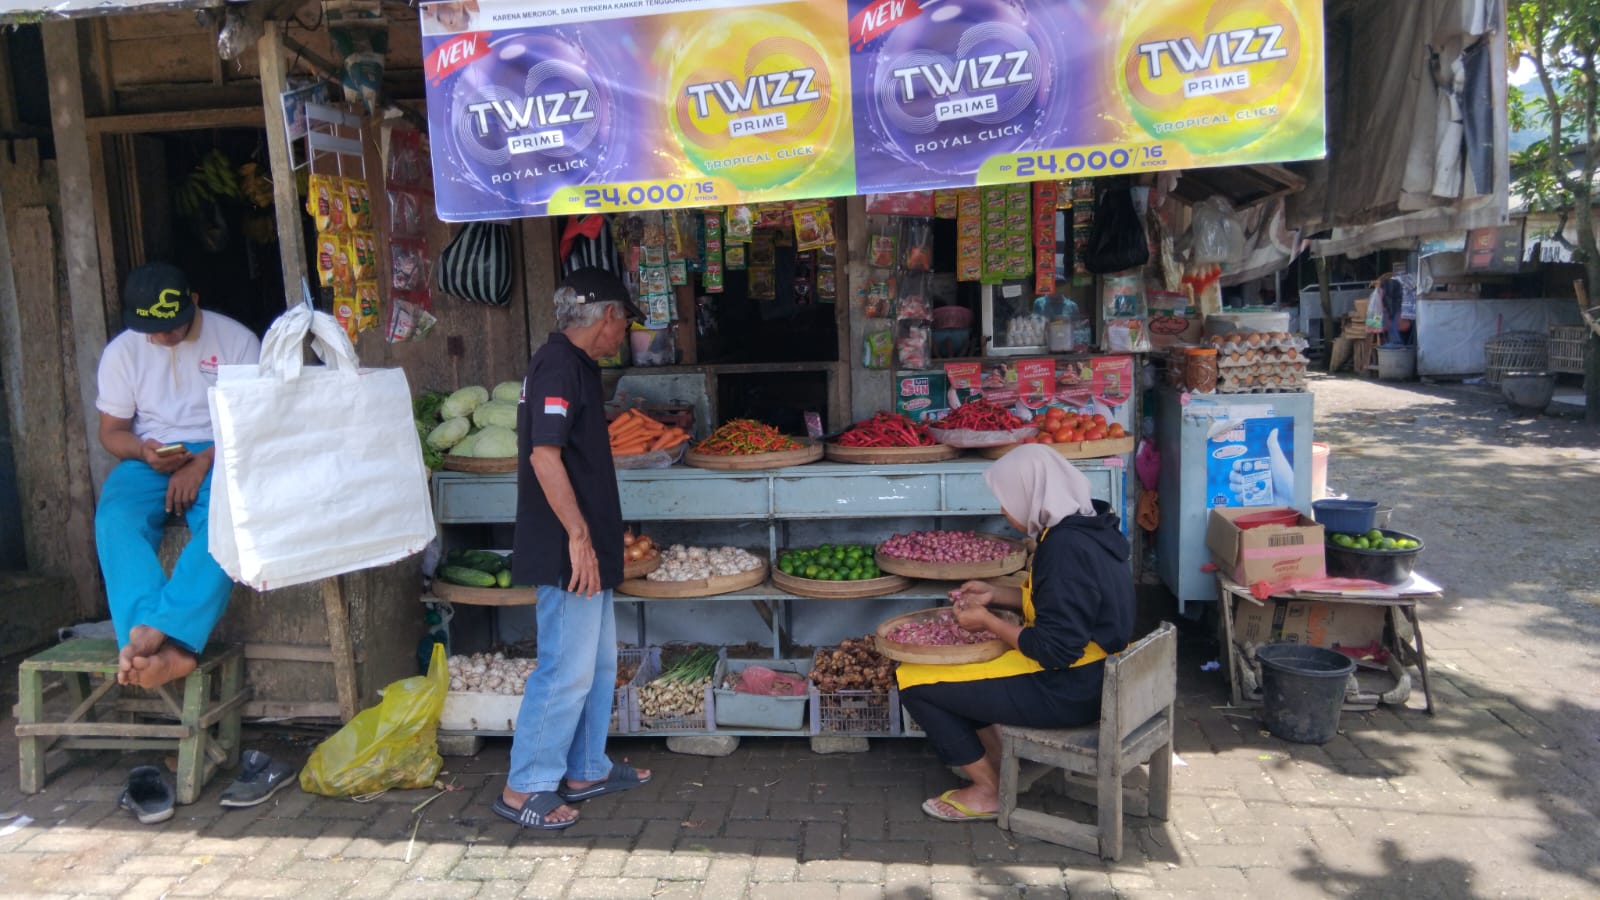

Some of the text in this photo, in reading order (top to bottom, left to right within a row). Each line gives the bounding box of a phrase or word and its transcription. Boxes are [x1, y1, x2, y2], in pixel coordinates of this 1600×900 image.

[522, 10, 559, 19] MEROKOK,
[579, 5, 613, 14] TERKENA
[614, 1, 644, 10] KANKER
[861, 0, 905, 35] NEW
[437, 32, 477, 72] NEW
[1139, 25, 1287, 79] TWIZZ
[893, 50, 1033, 103] TWIZZ
[1188, 75, 1247, 93] PRIME
[687, 68, 820, 119] TWIZZ
[468, 89, 595, 137] TWIZZ
[940, 99, 995, 117] PRIME
[1154, 105, 1278, 133] TROPICAL CLICK
[733, 115, 785, 133] PRIME
[512, 134, 561, 151] PRIME
[915, 124, 1024, 153] ROYAL CLICK
[491, 158, 588, 185] ROYAL CLICK
[705, 145, 814, 170] TROPICAL CLICK
